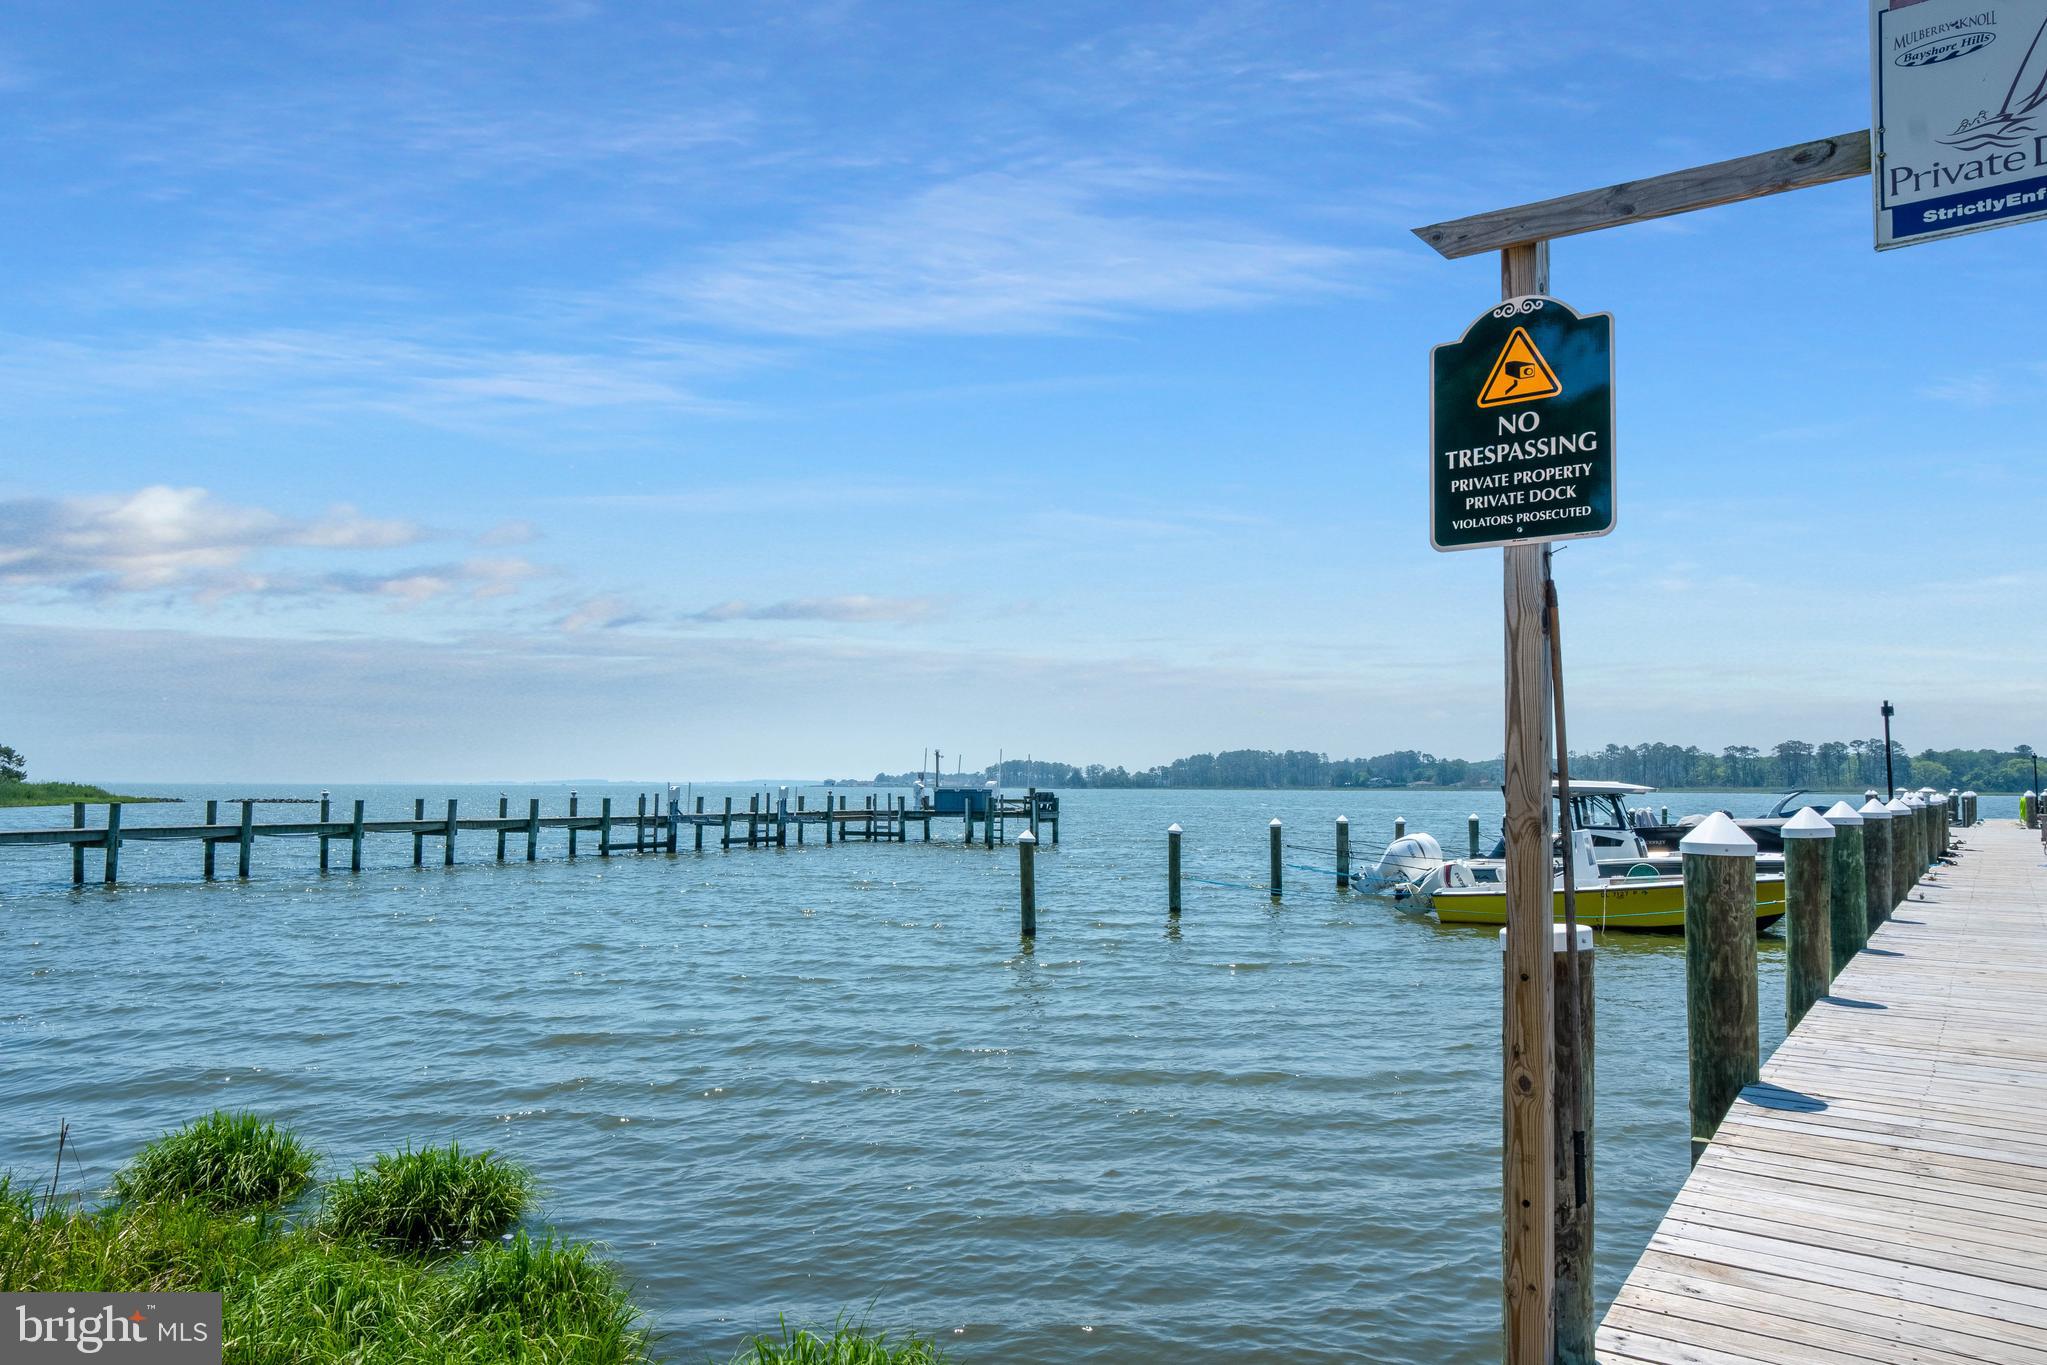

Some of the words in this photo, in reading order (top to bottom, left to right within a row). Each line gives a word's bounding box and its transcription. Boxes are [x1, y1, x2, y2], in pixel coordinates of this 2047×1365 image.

[1894, 22, 1952, 51] MULBERRY
[1959, 10, 1998, 29] KNOLL
[1903, 43, 1957, 63] Bayshore
[1961, 33, 1991, 48] Hills
[1890, 151, 2026, 197] Private
[1498, 411, 1540, 436] NO
[1445, 431, 1598, 470] TRESPASSING
[1451, 473, 1509, 493] PRIVATE
[1513, 462, 1593, 485] PROPERTY
[1465, 491, 1525, 510] PRIVATE
[1529, 484, 1577, 503] DOCK
[1452, 514, 1513, 530] VIOLATORS
[1516, 505, 1592, 523] PROSECUTED
